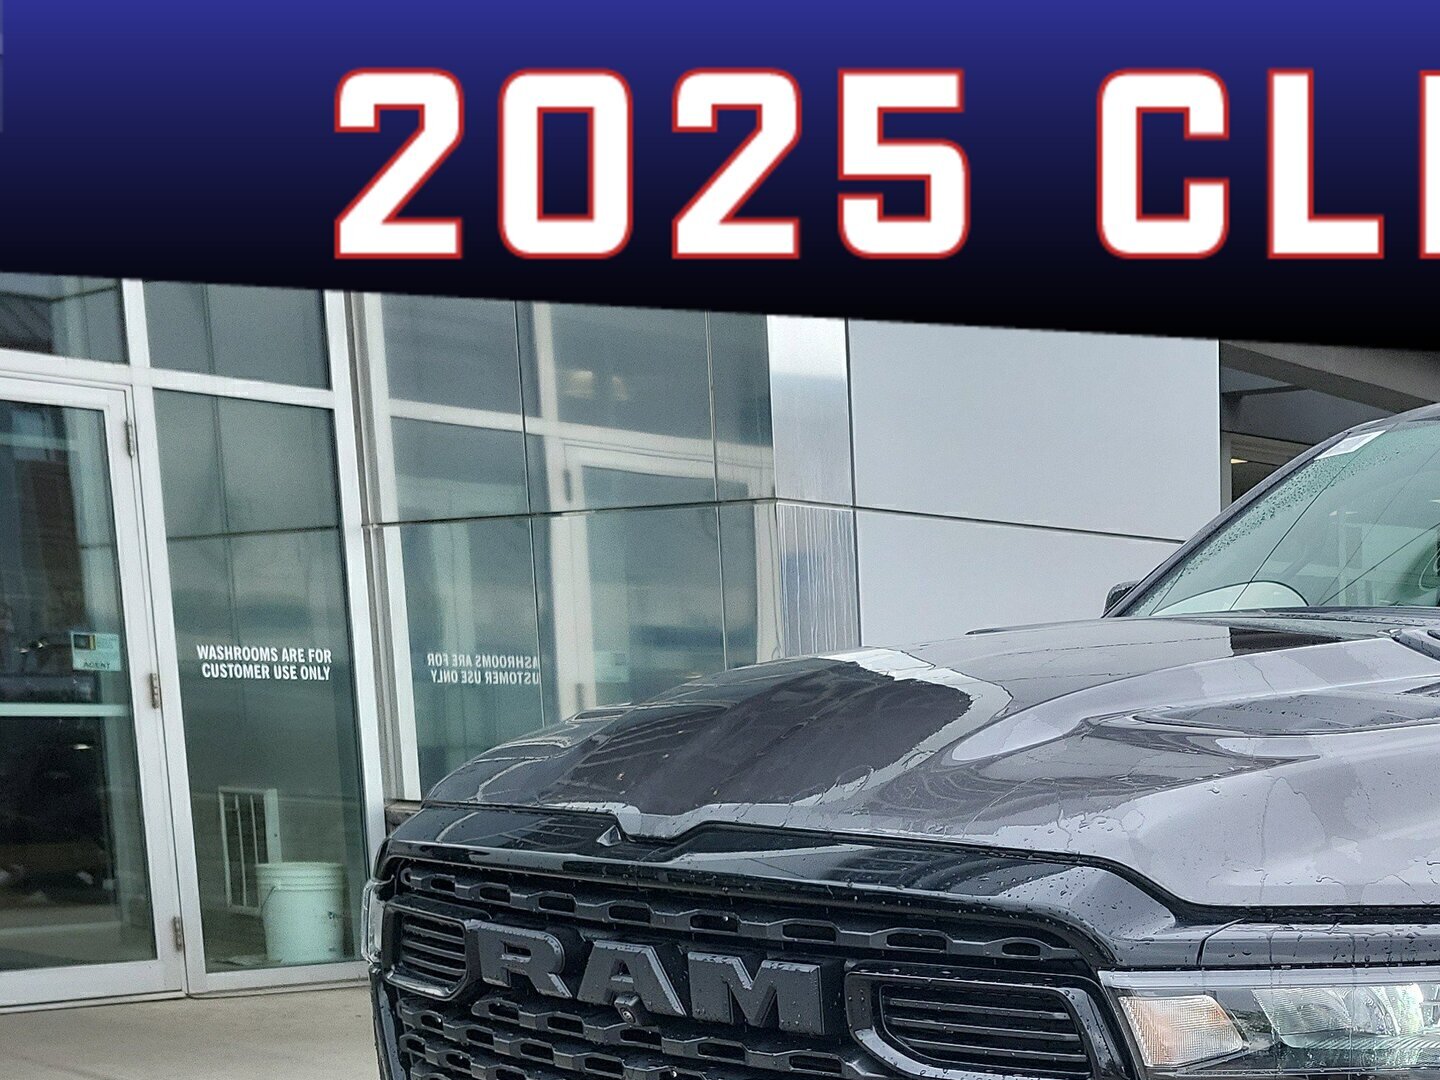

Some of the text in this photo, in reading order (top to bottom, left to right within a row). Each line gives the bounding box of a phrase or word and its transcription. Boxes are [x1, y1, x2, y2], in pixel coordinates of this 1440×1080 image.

[196, 644, 332, 663] WASHROOMS ARE FOR
[202, 662, 330, 680] CUSTOMER USE ONLY
[466, 919, 825, 1036] RAM
